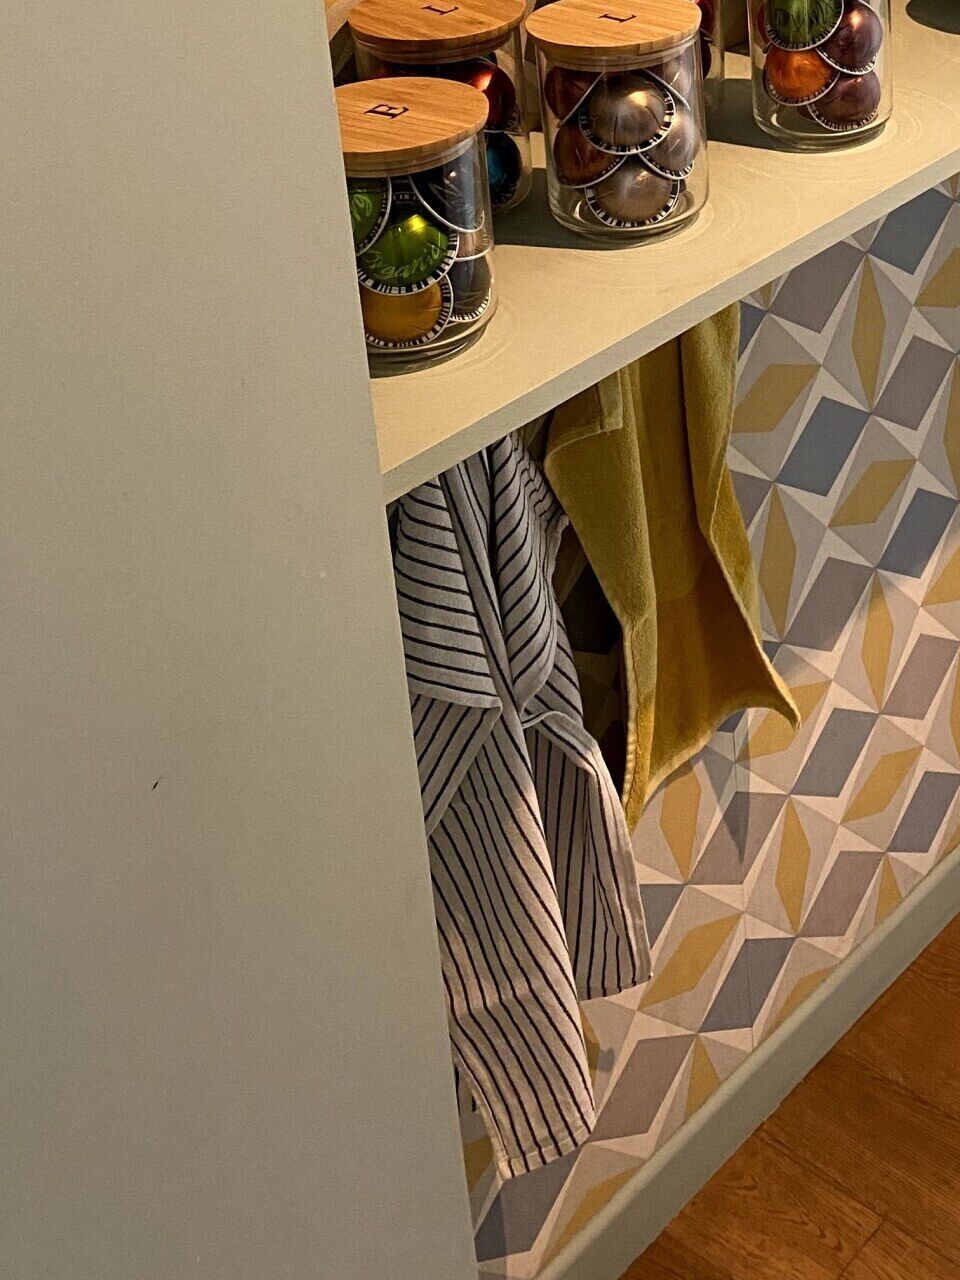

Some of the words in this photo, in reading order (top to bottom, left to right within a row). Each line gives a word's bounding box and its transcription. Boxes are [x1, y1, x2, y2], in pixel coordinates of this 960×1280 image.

[421, 4, 459, 16] L
[598, 12, 636, 24] L
[364, 103, 410, 120] E
